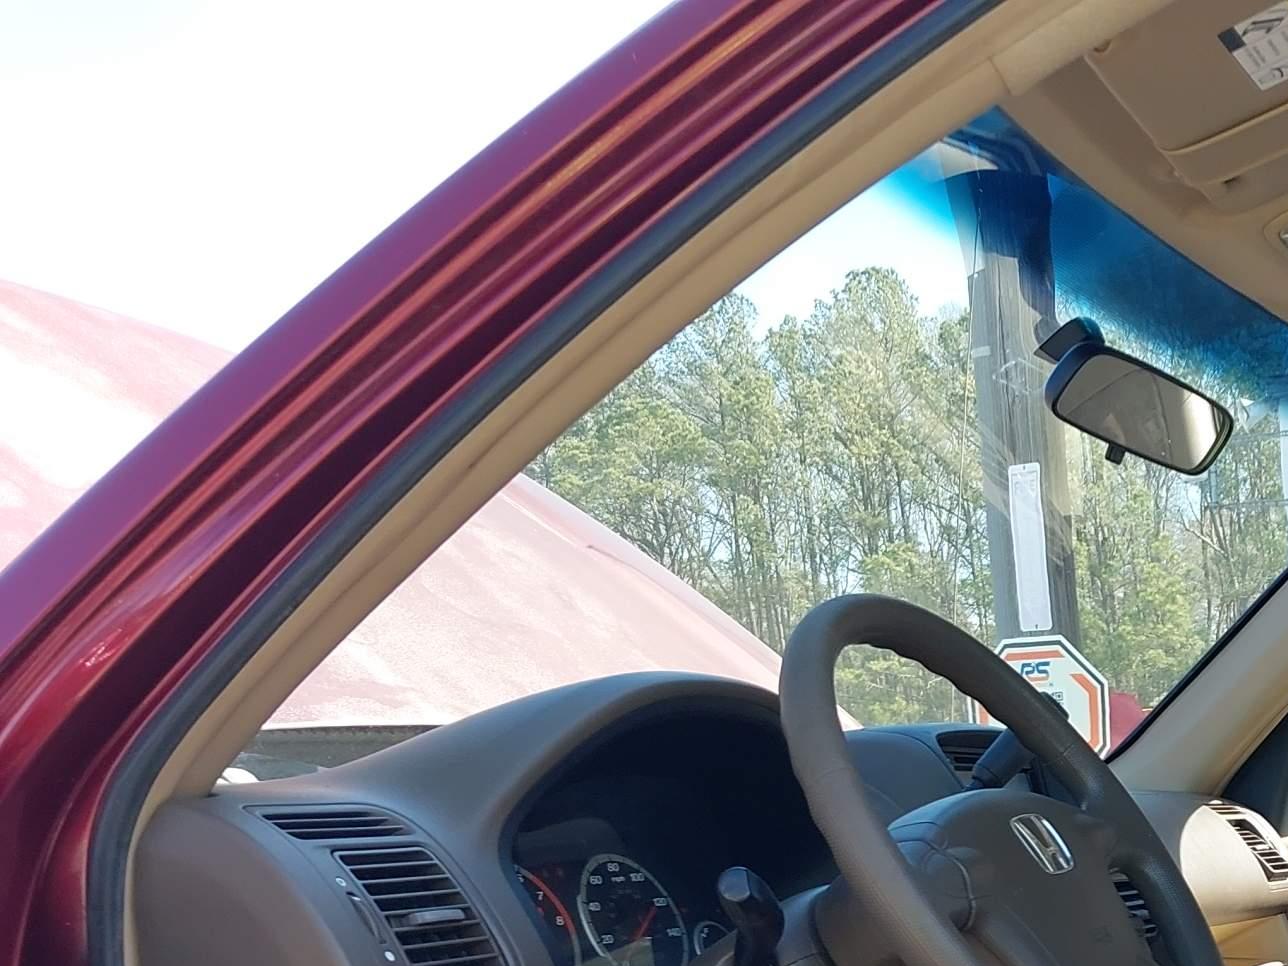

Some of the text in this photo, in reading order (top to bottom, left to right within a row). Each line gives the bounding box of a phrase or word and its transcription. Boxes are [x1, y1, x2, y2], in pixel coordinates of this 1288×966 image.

[607, 862, 620, 872] 80
[589, 875, 603, 885] 60
[629, 872, 645, 882] 100
[536, 891, 544, 900] 7
[588, 902, 601, 911] 40
[652, 897, 668, 906] 120
[555, 916, 565, 926] 8
[666, 927, 682, 937] 140
[601, 934, 615, 944] 20
